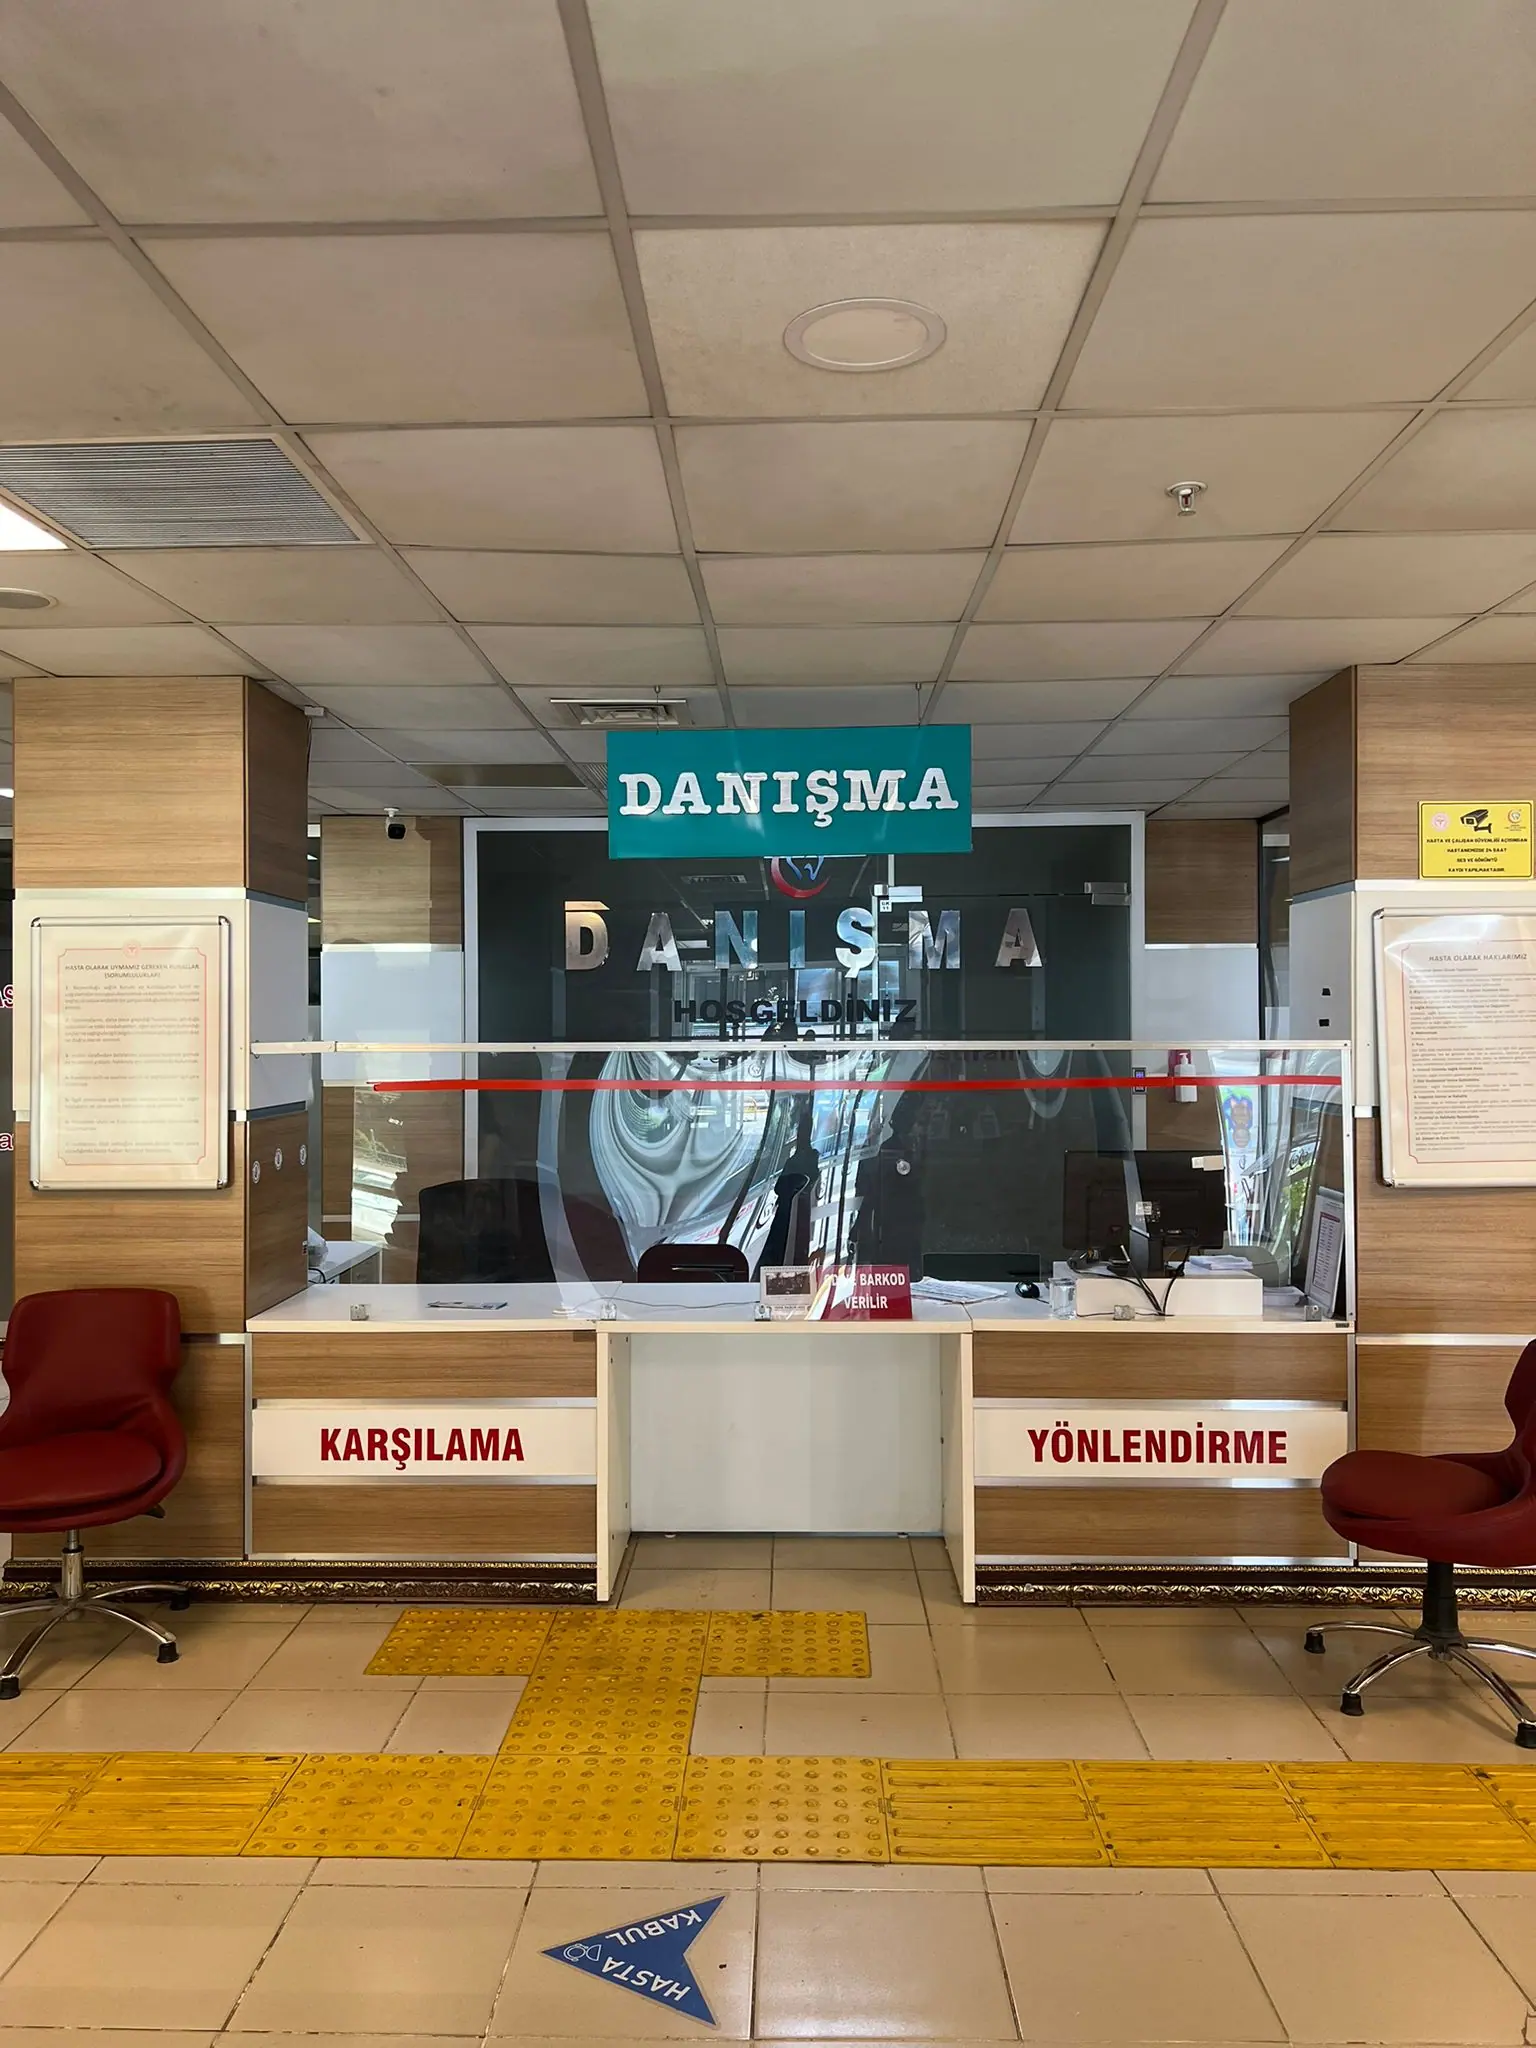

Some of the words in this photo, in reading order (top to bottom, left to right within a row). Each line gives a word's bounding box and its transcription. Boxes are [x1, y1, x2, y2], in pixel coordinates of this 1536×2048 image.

[618, 767, 960, 828] DANIŞMA
[564, 902, 1043, 979] DANIŞMA
[673, 991, 917, 1028] HOŞGELDİNİZ
[844, 1293, 888, 1309] VERİLİR
[859, 1273, 906, 1286] BARKOD
[320, 1427, 525, 1471] KARŞILAMA
[1027, 1421, 1288, 1464] YÖNLENDİRME
[605, 1909, 703, 1946] KABUL
[601, 1956, 691, 2001] HASTA
